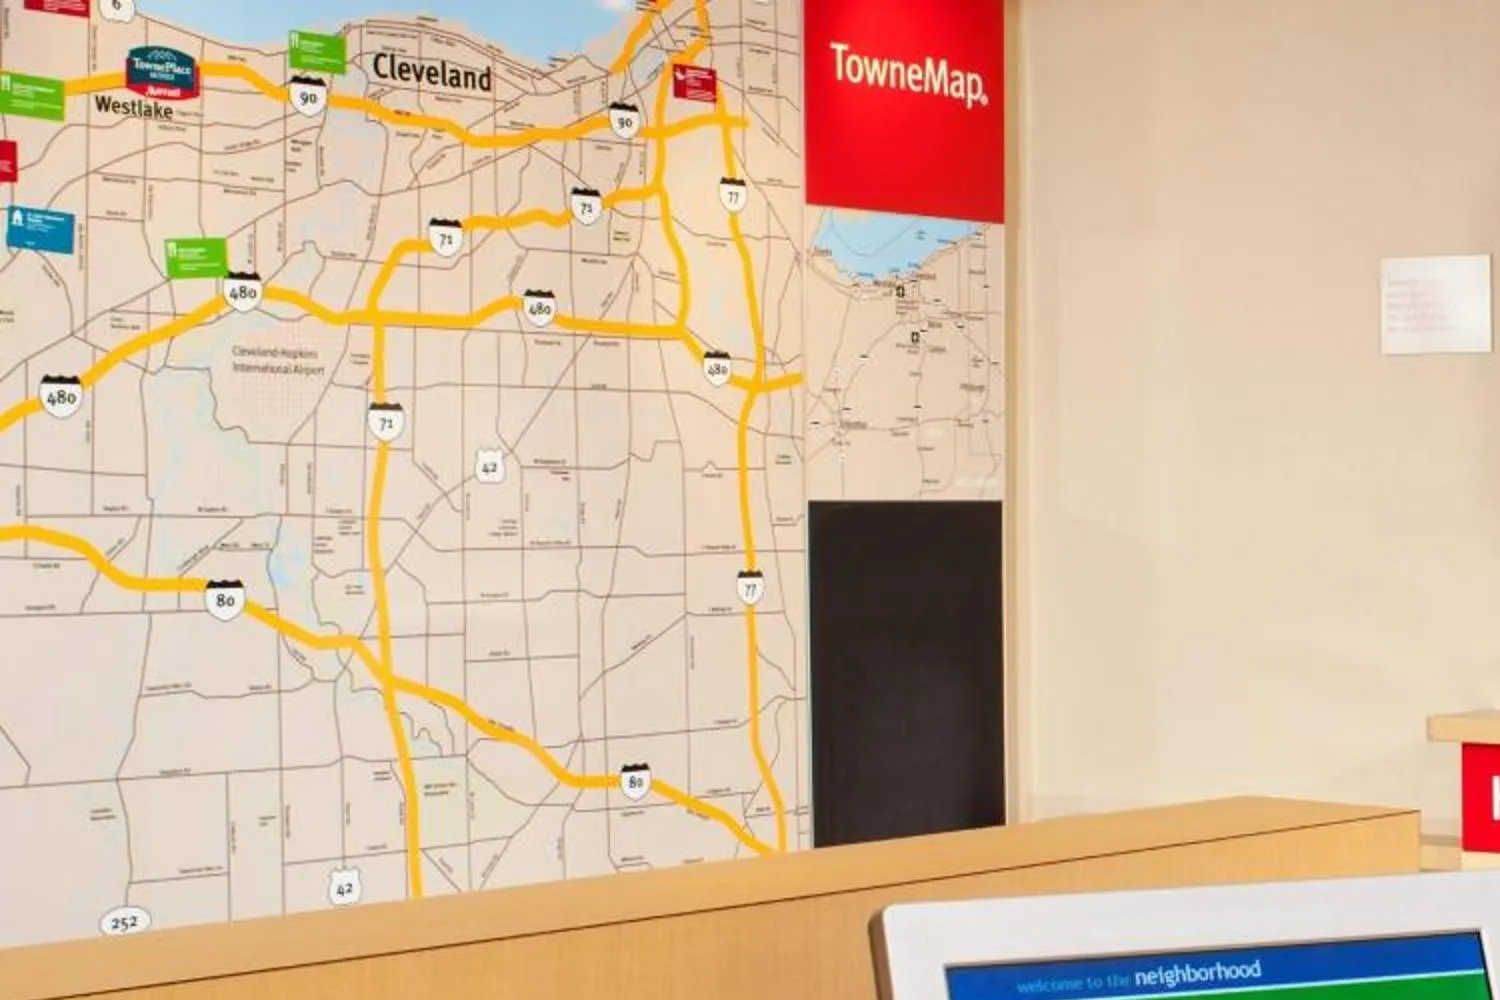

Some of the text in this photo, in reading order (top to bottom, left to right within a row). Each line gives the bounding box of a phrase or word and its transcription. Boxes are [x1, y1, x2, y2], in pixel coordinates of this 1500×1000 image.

[133, 57, 191, 74] TownePlace
[373, 53, 491, 92] Cleveland
[300, 91, 318, 106] 90
[95, 96, 173, 120] Westlake
[618, 118, 632, 129] 90
[728, 192, 739, 204] 77
[580, 203, 593, 216] 71
[439, 234, 453, 247] 71
[229, 286, 257, 300] 480
[528, 302, 552, 316] 480
[232, 361, 325, 377] International Airport
[707, 363, 728, 376] 480
[46, 389, 76, 405] 480
[380, 418, 393, 431] 71
[481, 460, 497, 475] 42
[745, 583, 757, 597] 77
[216, 594, 235, 607] 80
[629, 777, 644, 788] 80
[336, 882, 353, 897] 42
[111, 916, 139, 932] 252
[1017, 959, 1262, 994] welcome to the neighborhood
